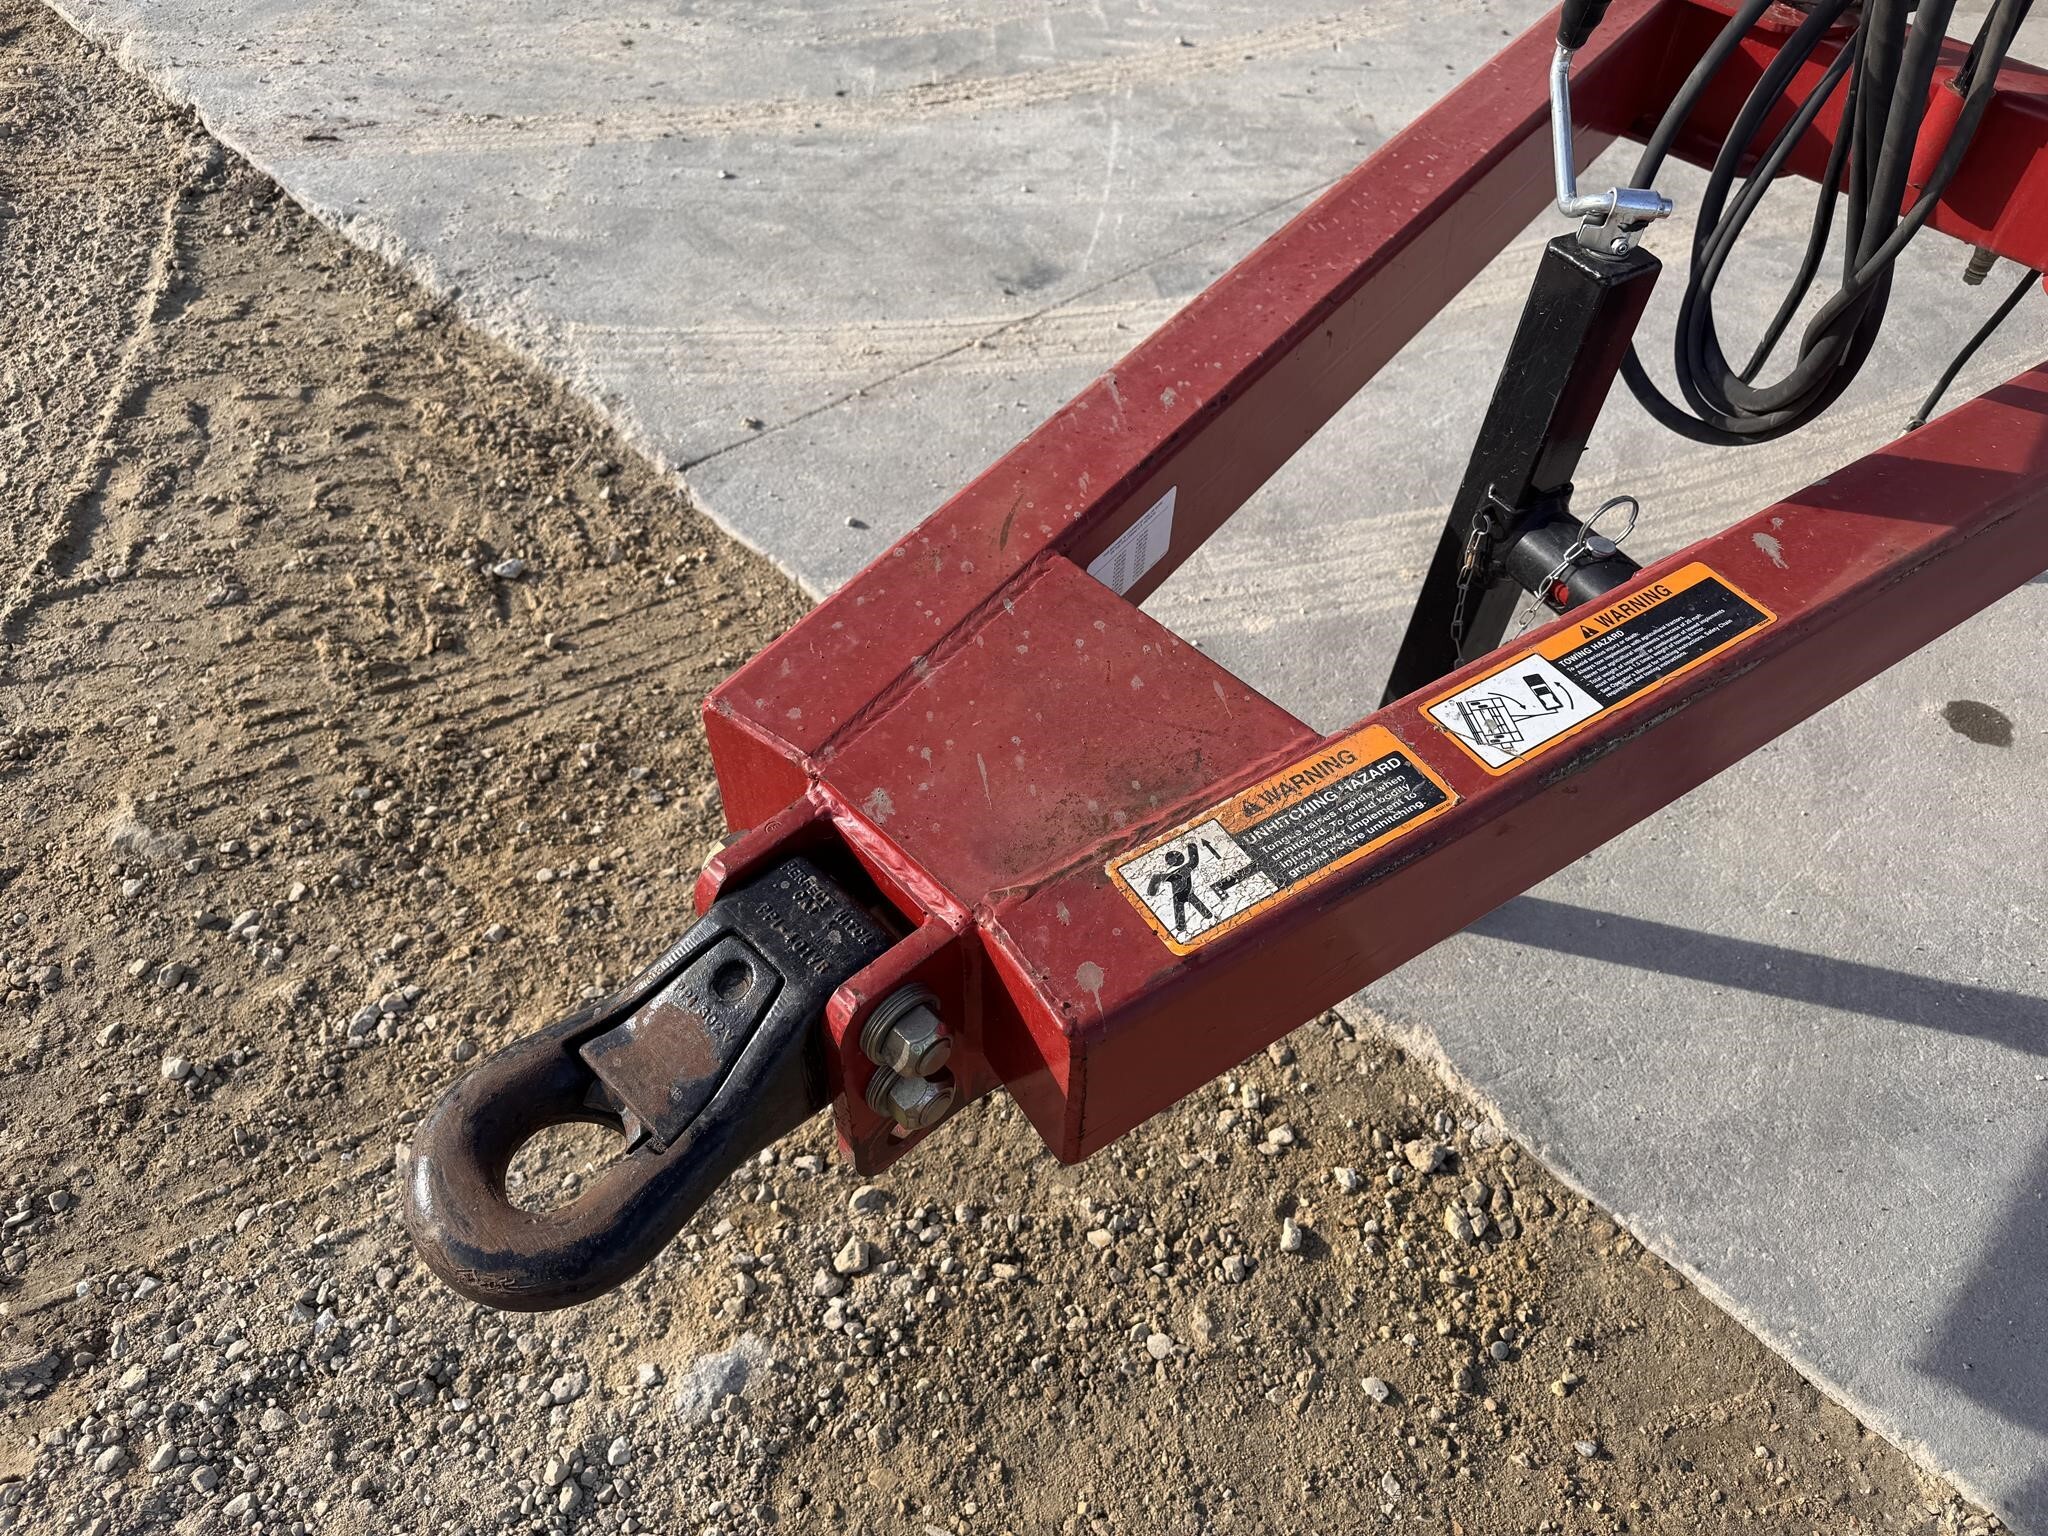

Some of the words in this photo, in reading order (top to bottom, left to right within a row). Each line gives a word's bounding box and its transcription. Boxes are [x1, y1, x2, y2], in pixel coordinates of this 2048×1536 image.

[1594, 583, 1672, 628] WARNING
[1558, 646, 1593, 667] TOWING
[1590, 629, 1625, 650] HAZARD
[1242, 789, 1339, 845] UNHITCHING
[1337, 756, 1402, 794] HAZARD
[1259, 747, 1357, 806] WARNING
[1259, 828, 1304, 855] Tongue
[1302, 810, 1337, 831] raises
[1336, 789, 1377, 814] rapidly
[1375, 774, 1406, 792] when
[1269, 825, 1330, 861] unhitched.
[1329, 817, 1345, 828] To
[1345, 800, 1377, 820] avoid
[1376, 783, 1412, 804] bodily
[1286, 851, 1330, 877] ground
[1364, 798, 1428, 834] unhitching.
[1316, 828, 1348, 848] lower
[1347, 798, 1406, 832] implement
[1404, 791, 1417, 800] to
[779, 859, 836, 907] PERFECT
